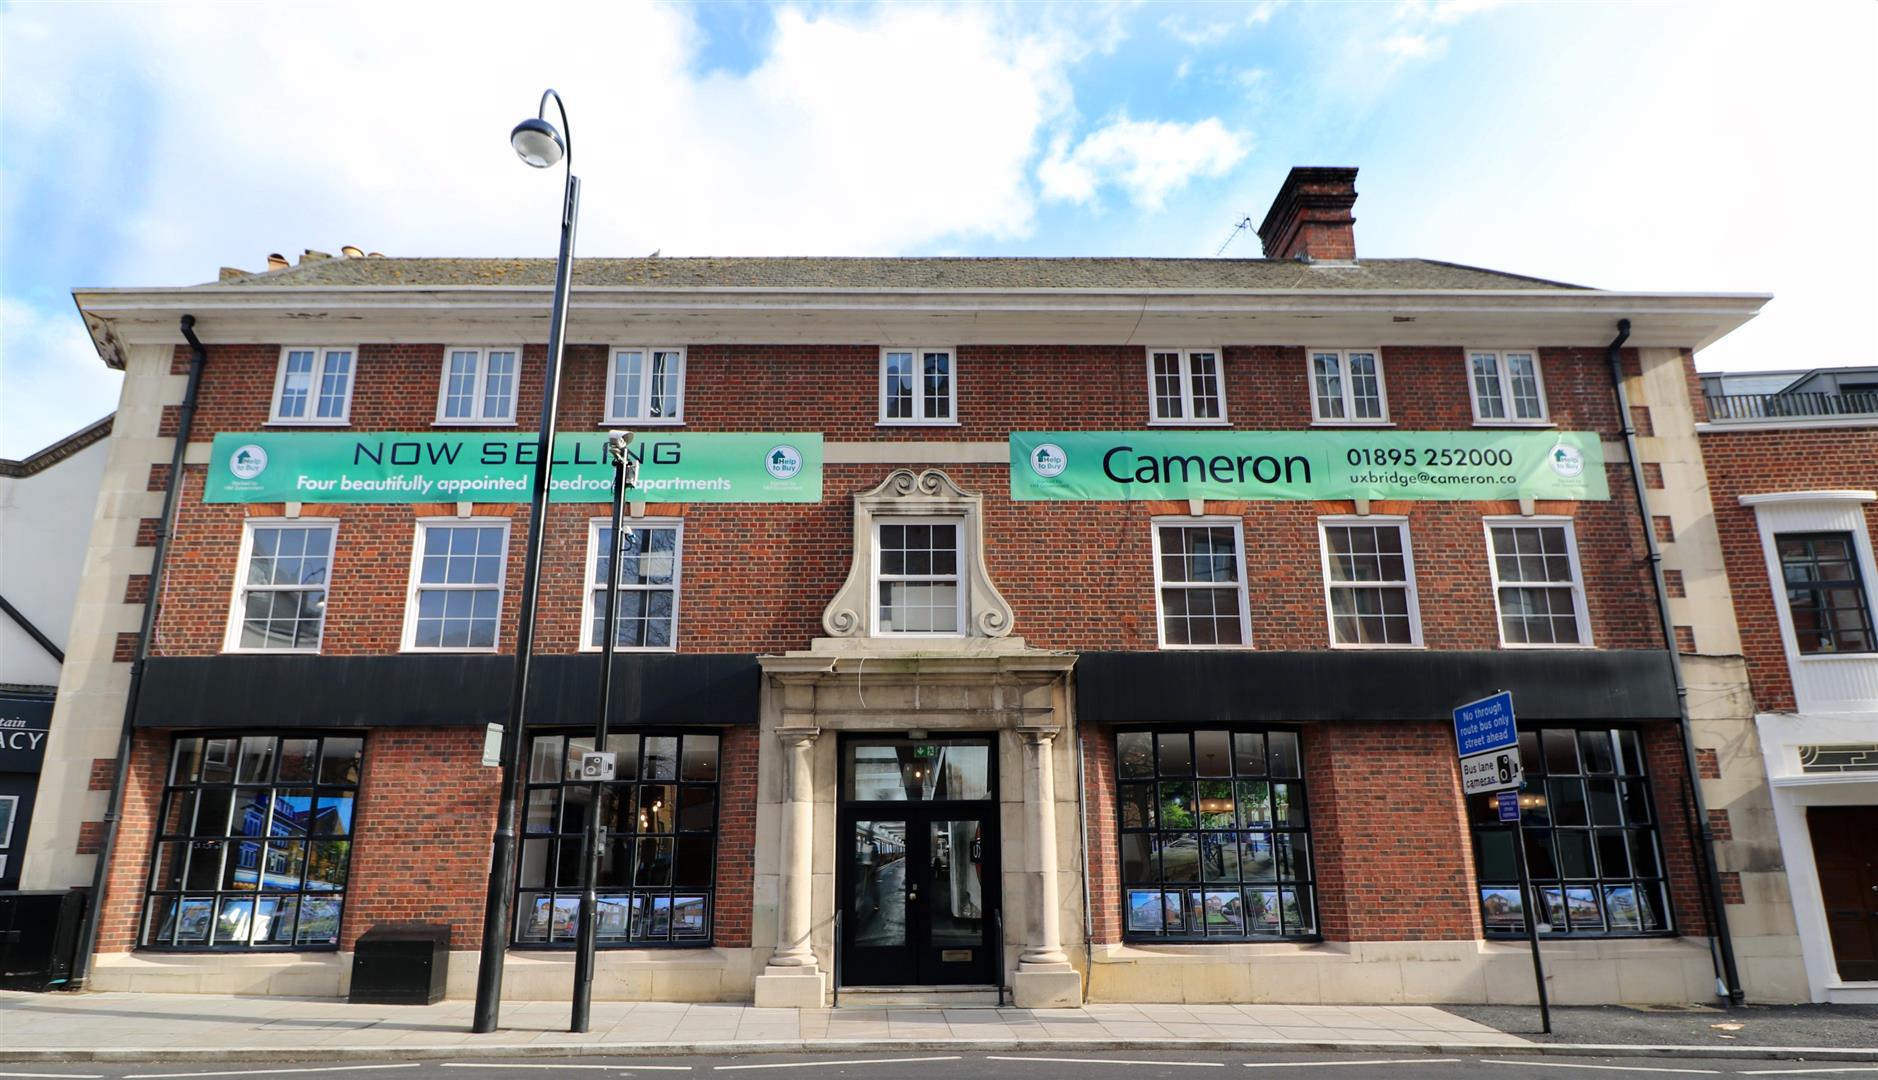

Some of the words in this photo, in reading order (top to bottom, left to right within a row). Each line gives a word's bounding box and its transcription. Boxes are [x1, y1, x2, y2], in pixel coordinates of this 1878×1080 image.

[353, 442, 463, 465] NOW
[1347, 448, 1417, 466] 01895
[1424, 448, 1513, 466] 252000
[782, 464, 796, 472] Buy
[1103, 446, 1311, 484] Cameron
[297, 474, 338, 490] Four
[340, 474, 433, 495] beautifully
[437, 474, 527, 494] appointed
[549, 474, 616, 490] bedroo
[633, 477, 731, 494] apartments
[1350, 470, 1517, 487] uxbridge@cameron.co
[1463, 711, 1473, 722] No
[1475, 702, 1502, 718] through
[1461, 724, 1478, 736] route
[1479, 721, 1492, 731] bus
[1494, 715, 1509, 727] only
[1465, 736, 1485, 749] street
[1488, 729, 1508, 743] ahead
[1464, 764, 1476, 775] Bus
[1479, 763, 1493, 772] lane
[1467, 776, 1496, 788] cameras
